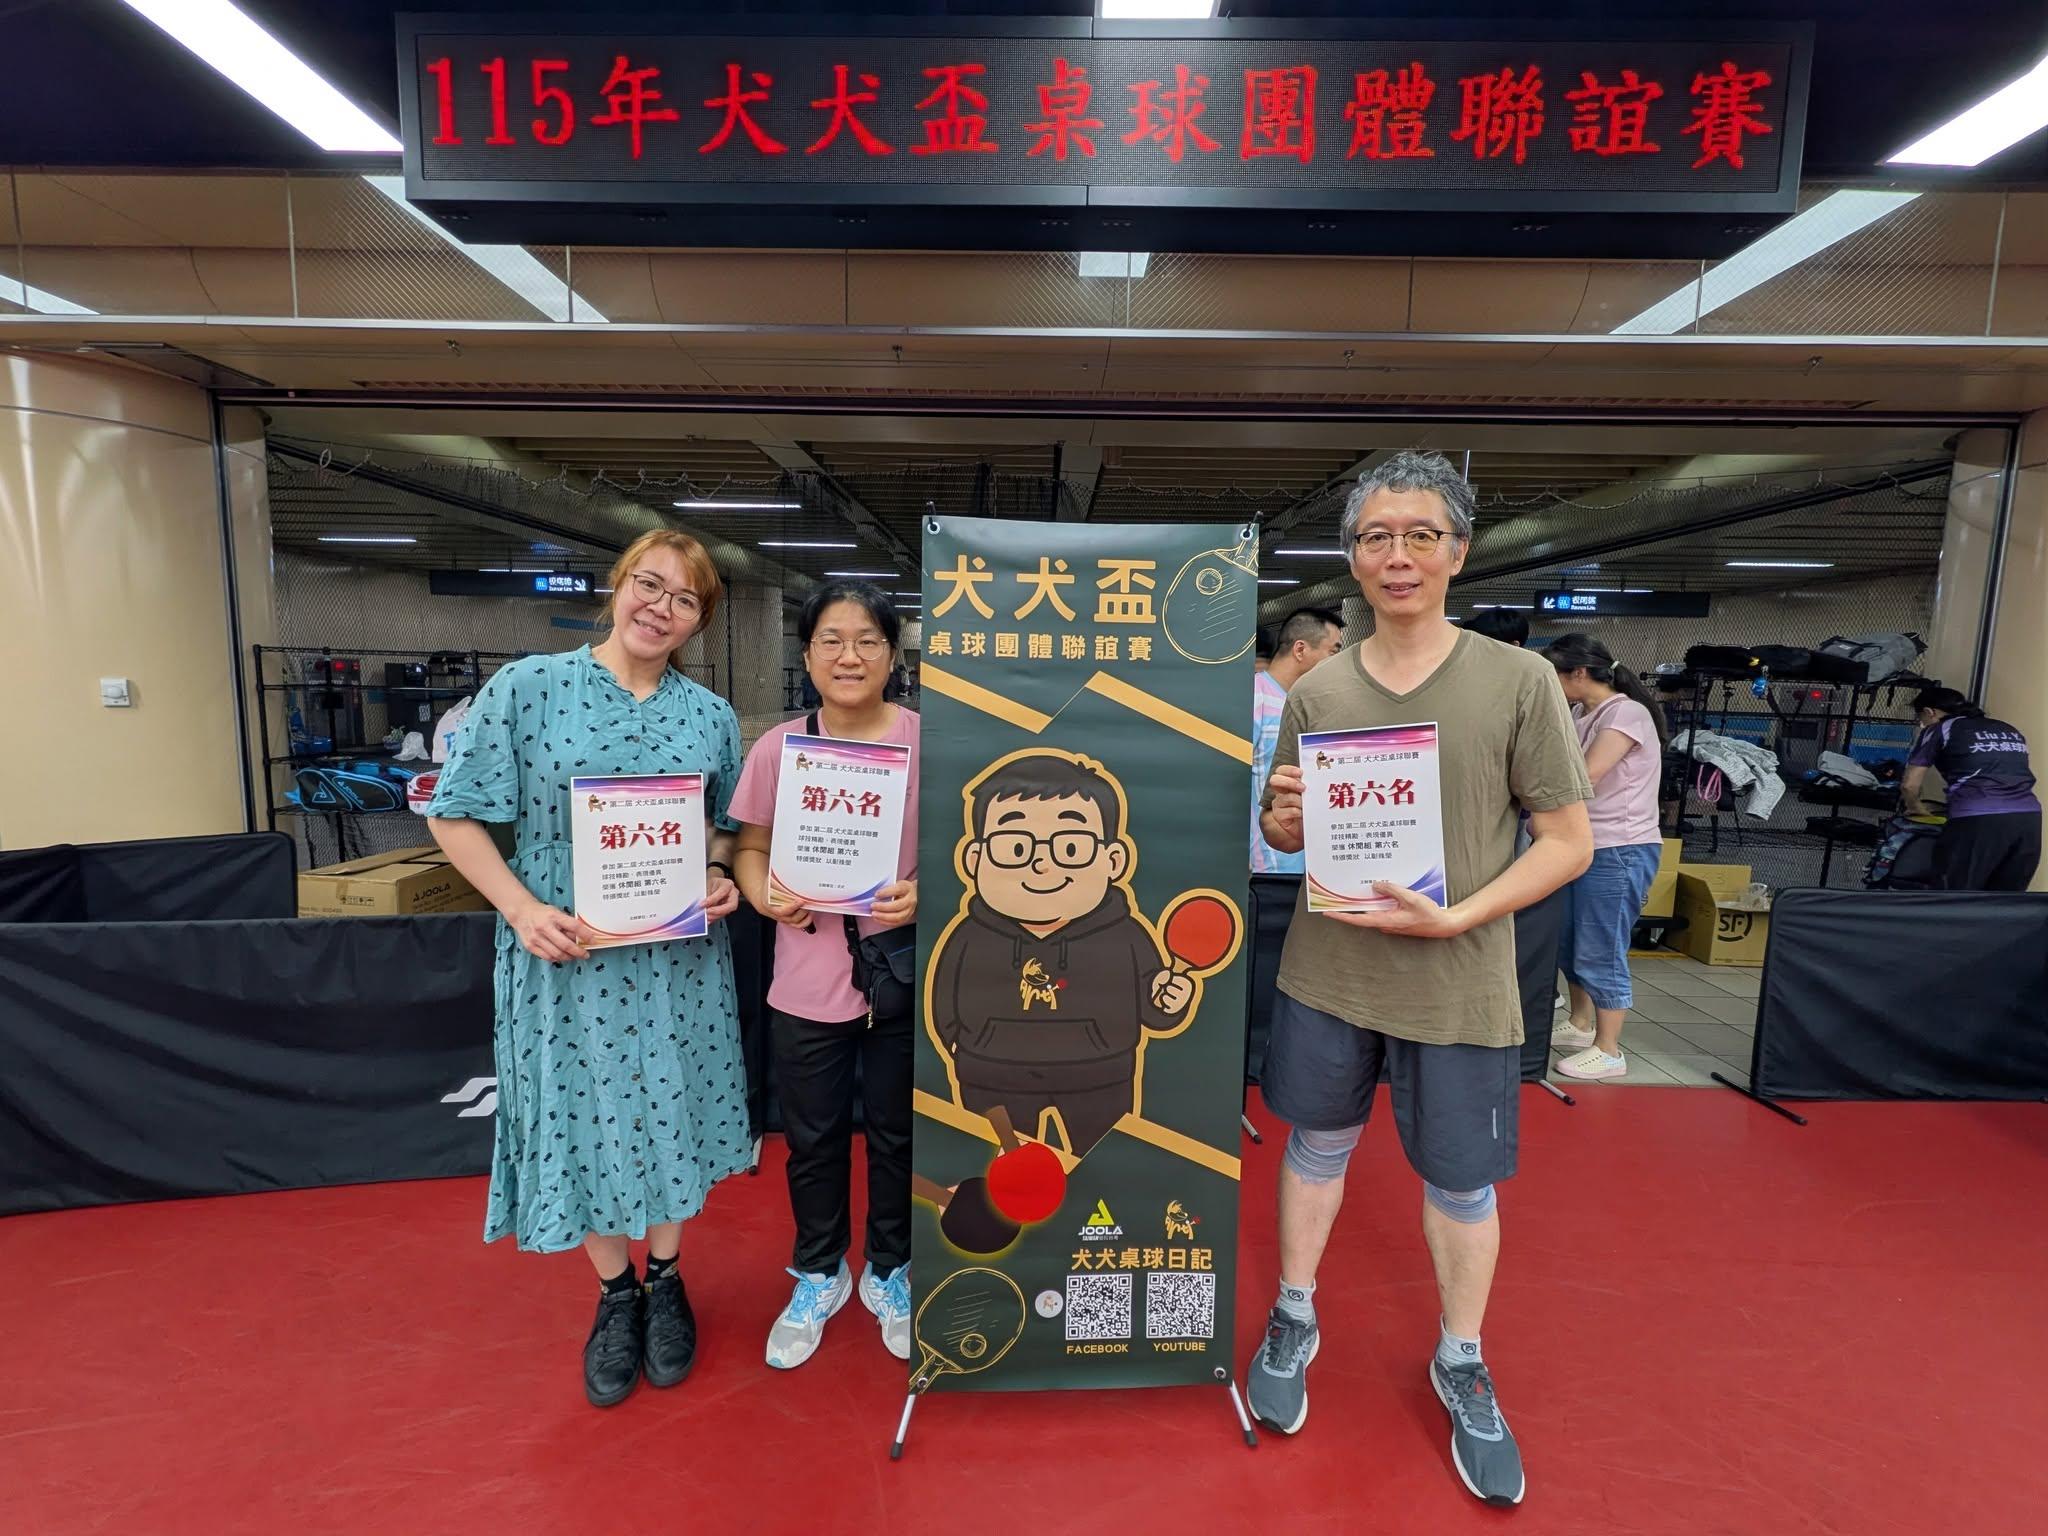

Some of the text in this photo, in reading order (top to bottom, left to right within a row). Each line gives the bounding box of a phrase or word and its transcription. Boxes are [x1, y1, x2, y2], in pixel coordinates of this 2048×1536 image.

[426, 56, 1773, 169] 115年犬犬盃桌球團體聯誼賽
[931, 554, 1157, 624] 犬犬盃
[928, 631, 1152, 661] 桌球團體聯誼賽
[1975, 731, 1999, 740] Liu
[801, 784, 882, 818] 第六名
[1327, 778, 1415, 810] 第六名
[599, 821, 682, 850] 第六名
[1718, 914, 1747, 933] SF
[1078, 1226, 1123, 1236] JOOLA
[1071, 1248, 1212, 1271] 犬犬桌球日記
[1066, 1343, 1129, 1354] FACEBOOK
[1153, 1342, 1206, 1352] YOUTUBE
